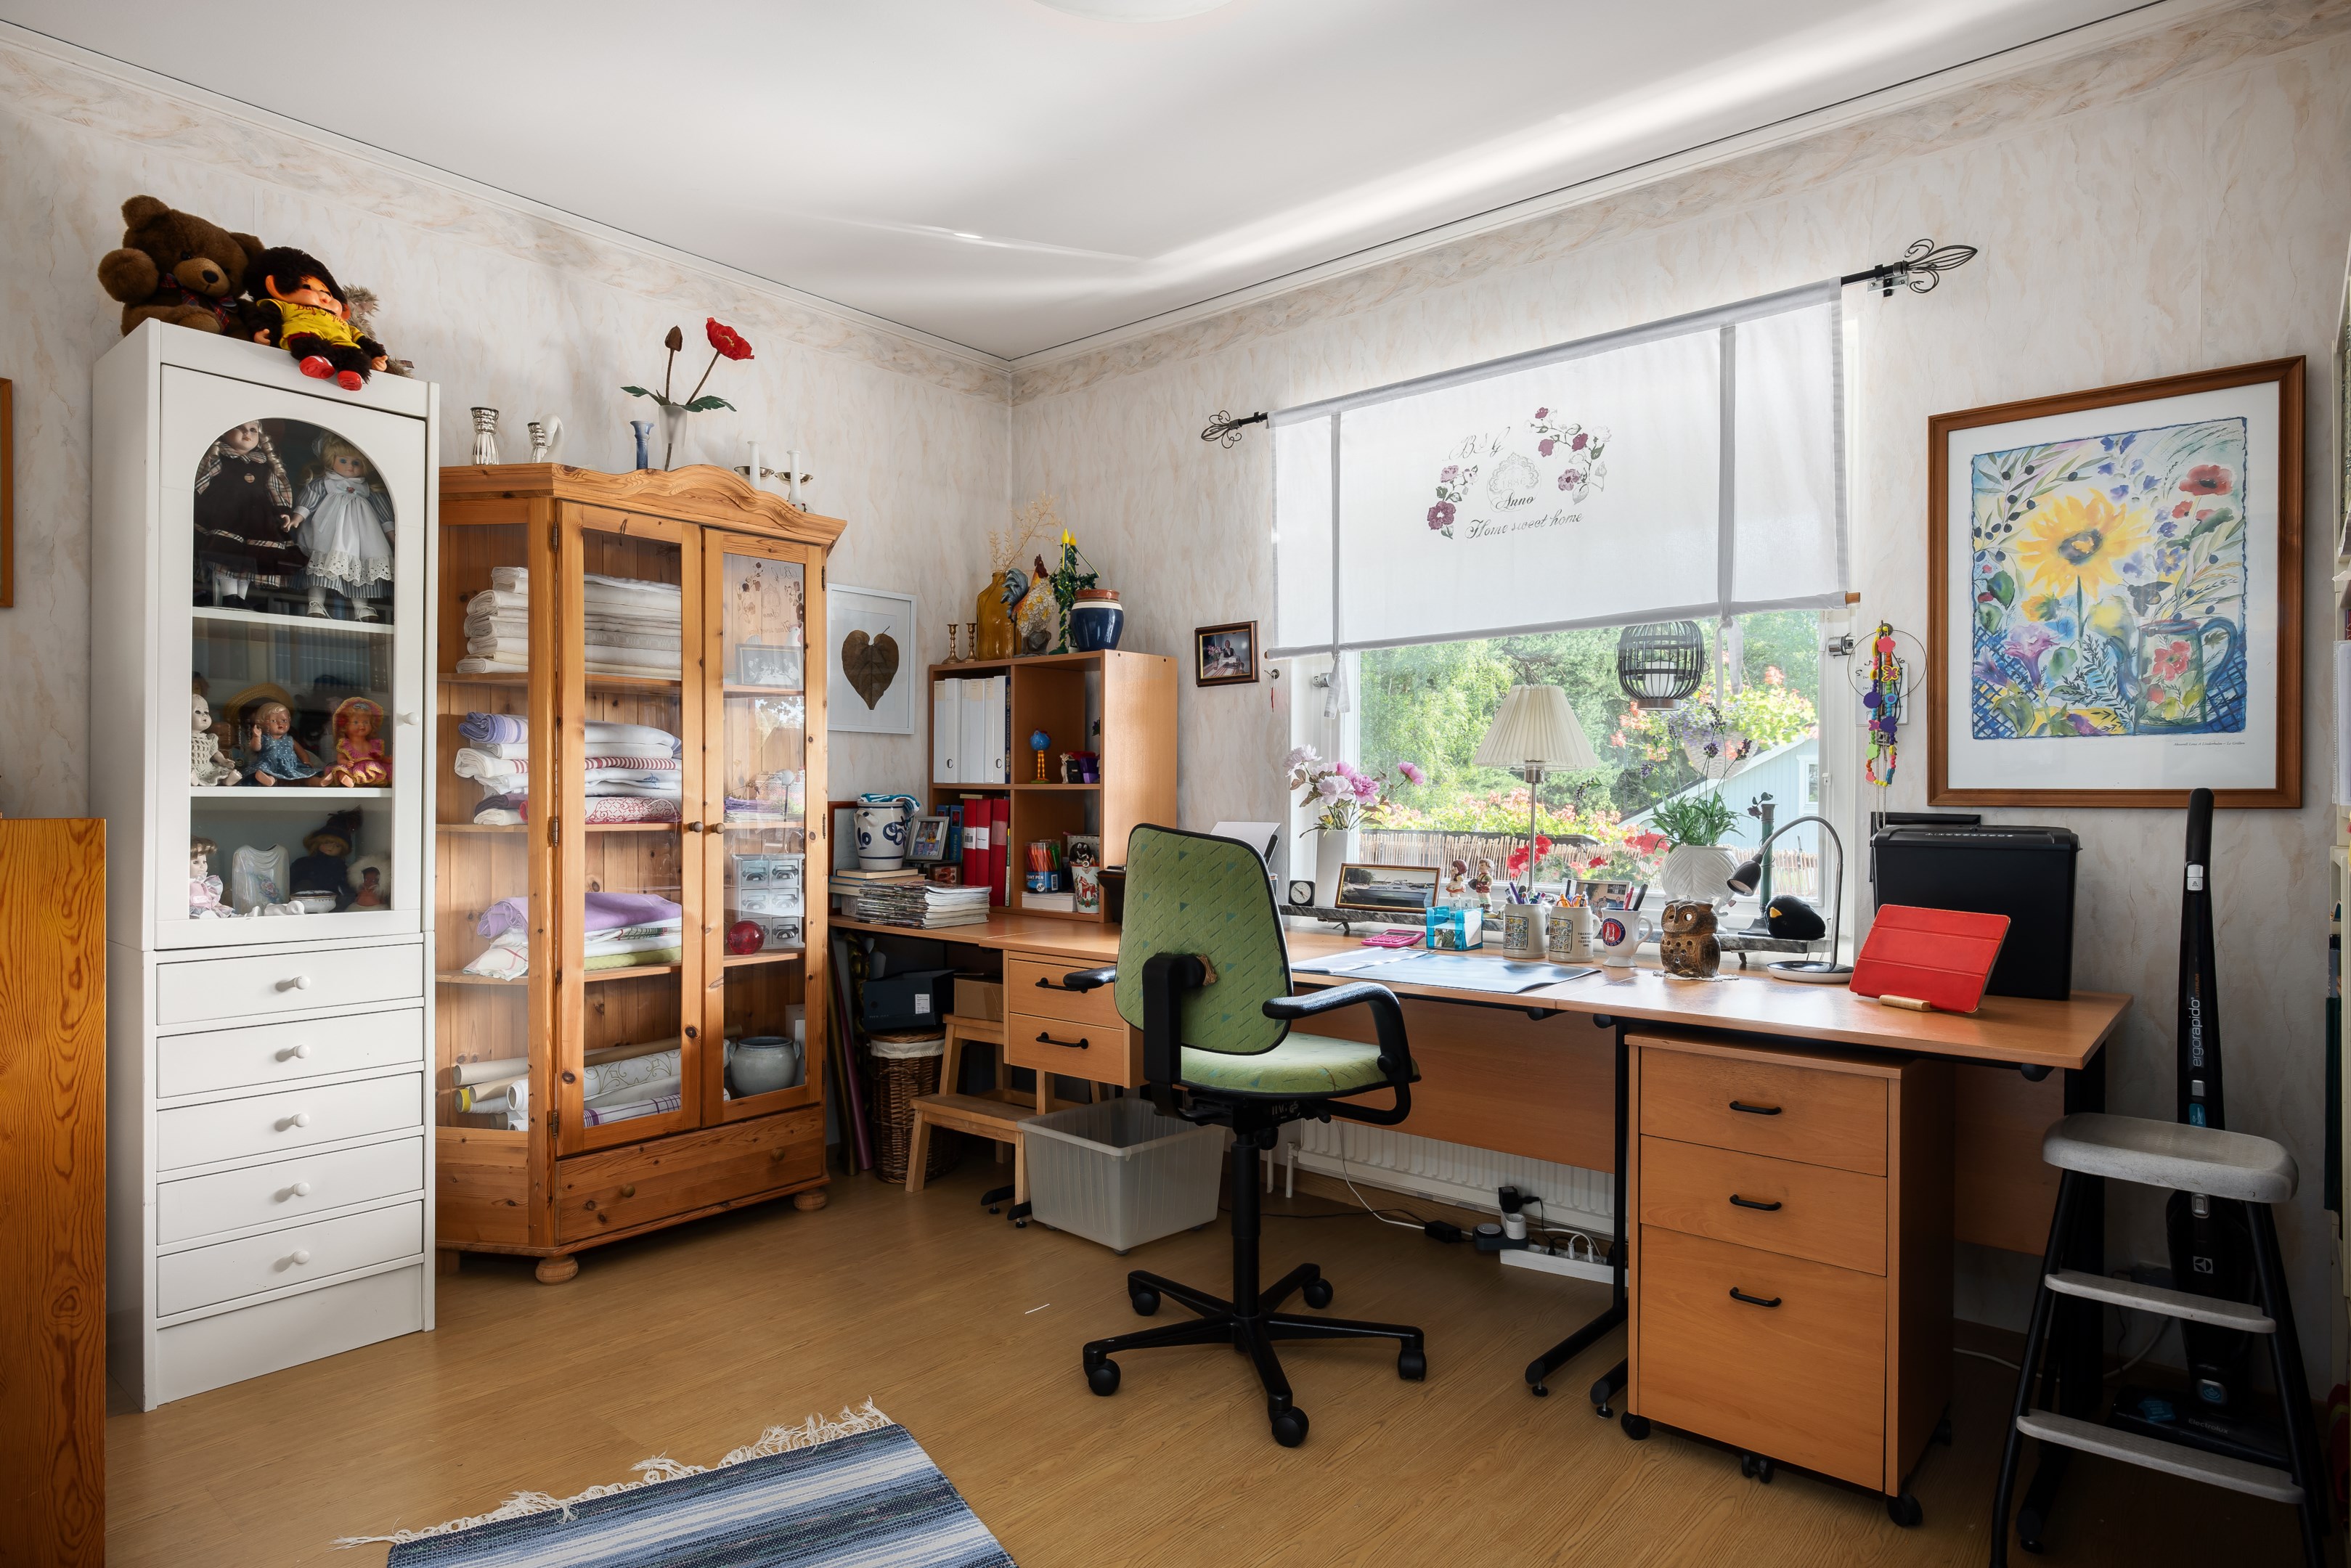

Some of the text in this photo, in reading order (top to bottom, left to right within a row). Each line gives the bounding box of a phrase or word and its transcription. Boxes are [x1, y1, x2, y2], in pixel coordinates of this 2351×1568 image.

[1494, 491, 1536, 511] Anno
[1464, 509, 1584, 539] Home sweet home
[2188, 999, 2204, 1067] ergorapido
[2188, 1417, 2229, 1434] Electrolux
